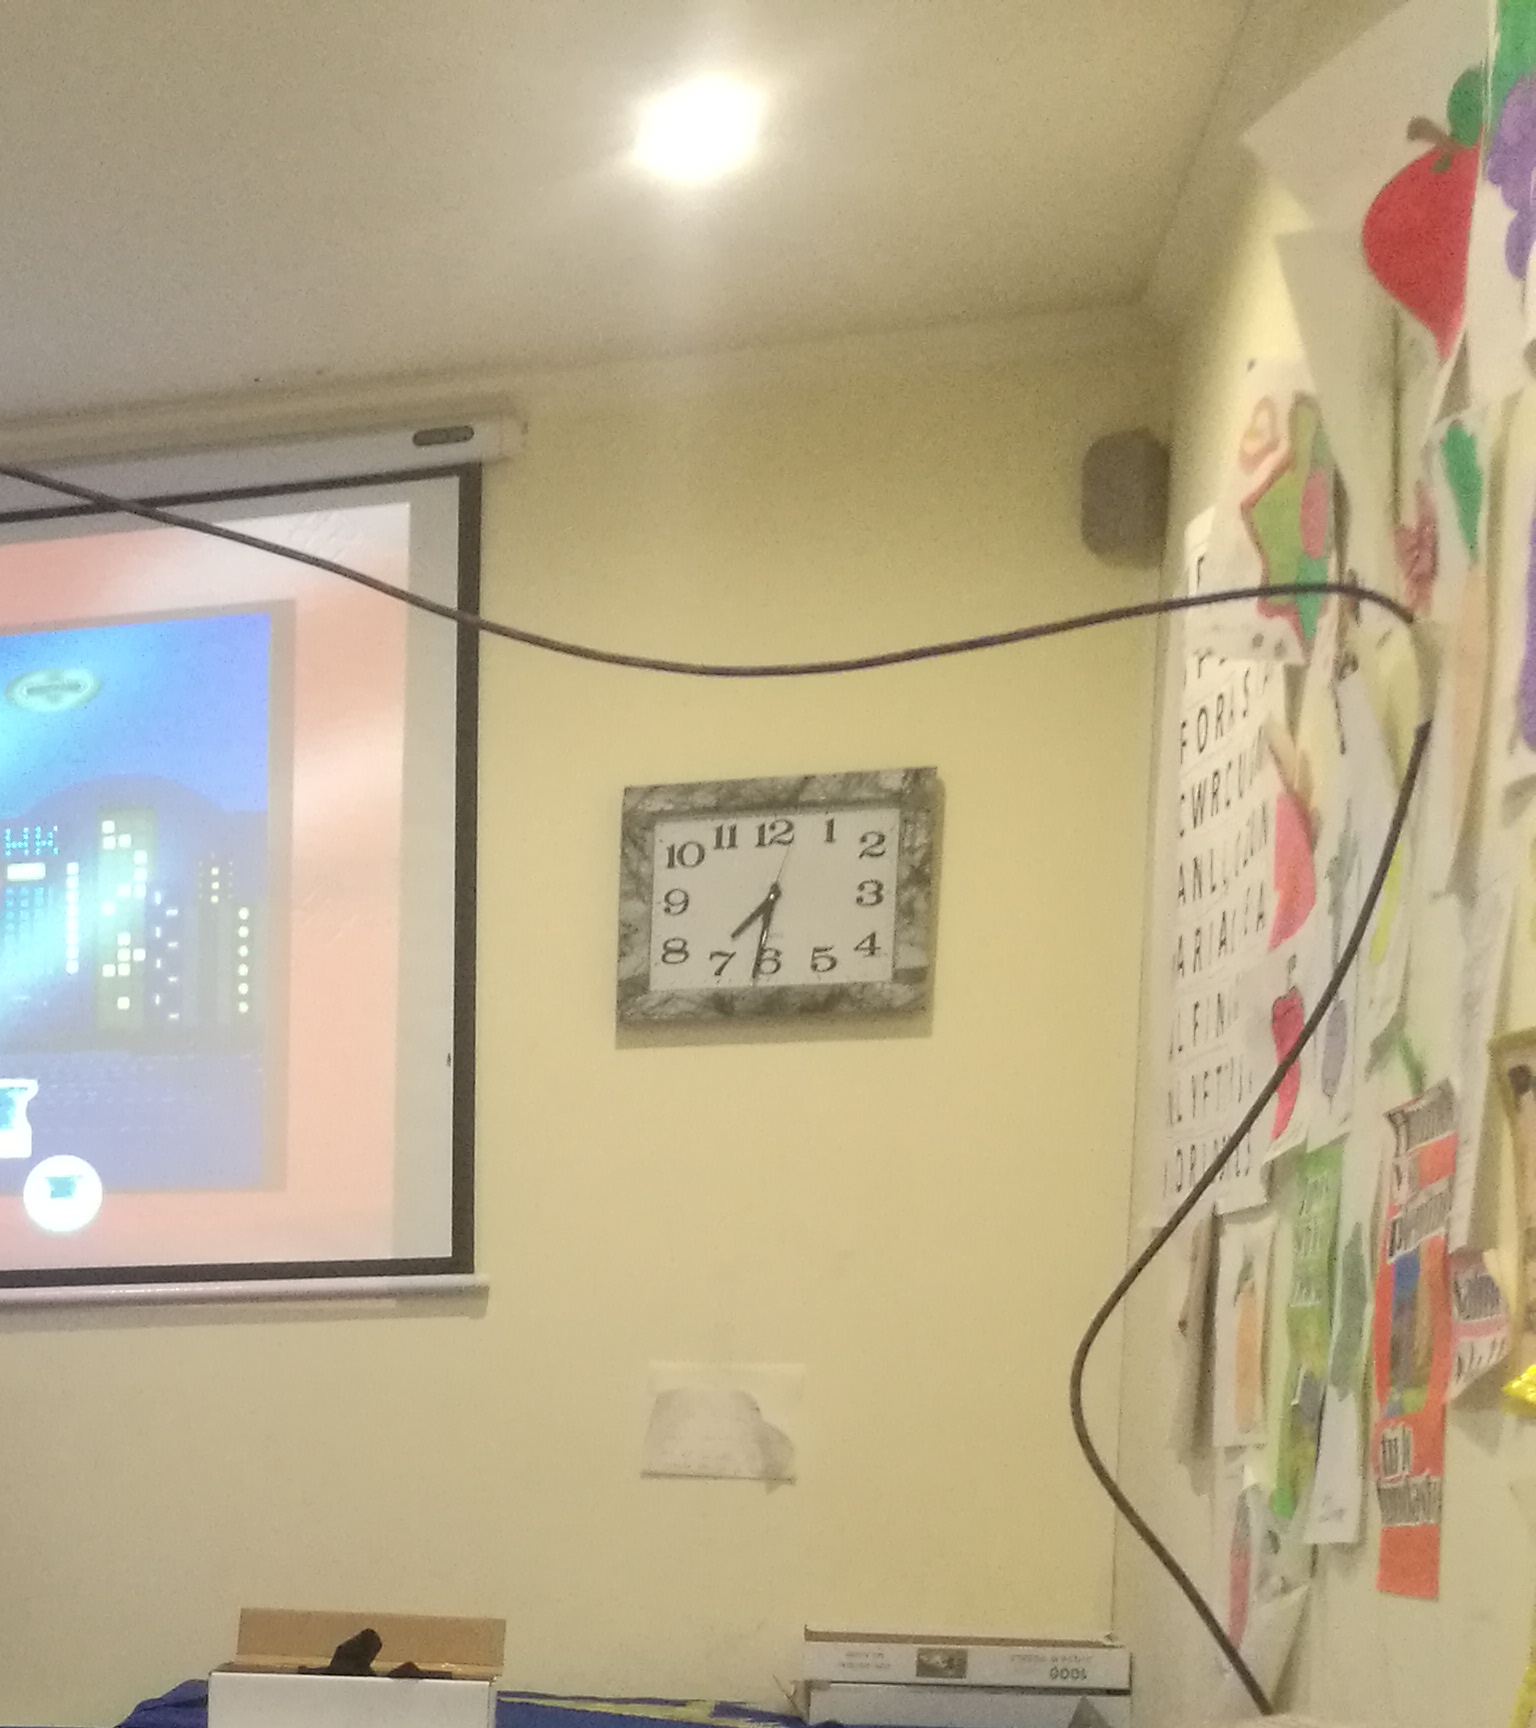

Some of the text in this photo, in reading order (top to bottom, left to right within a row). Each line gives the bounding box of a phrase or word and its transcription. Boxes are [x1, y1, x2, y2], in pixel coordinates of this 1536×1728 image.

[713, 823, 738, 850] 11
[755, 818, 795, 848] 12
[824, 817, 837, 844] 1
[666, 840, 706, 869] 10
[858, 830, 887, 860] 2
[663, 888, 690, 916] 9
[855, 879, 885, 906] 3
[661, 937, 690, 965] 8
[853, 931, 882, 958] 4
[708, 950, 736, 976] 7
[757, 947, 783, 975] 6
[810, 945, 838, 973] 5
